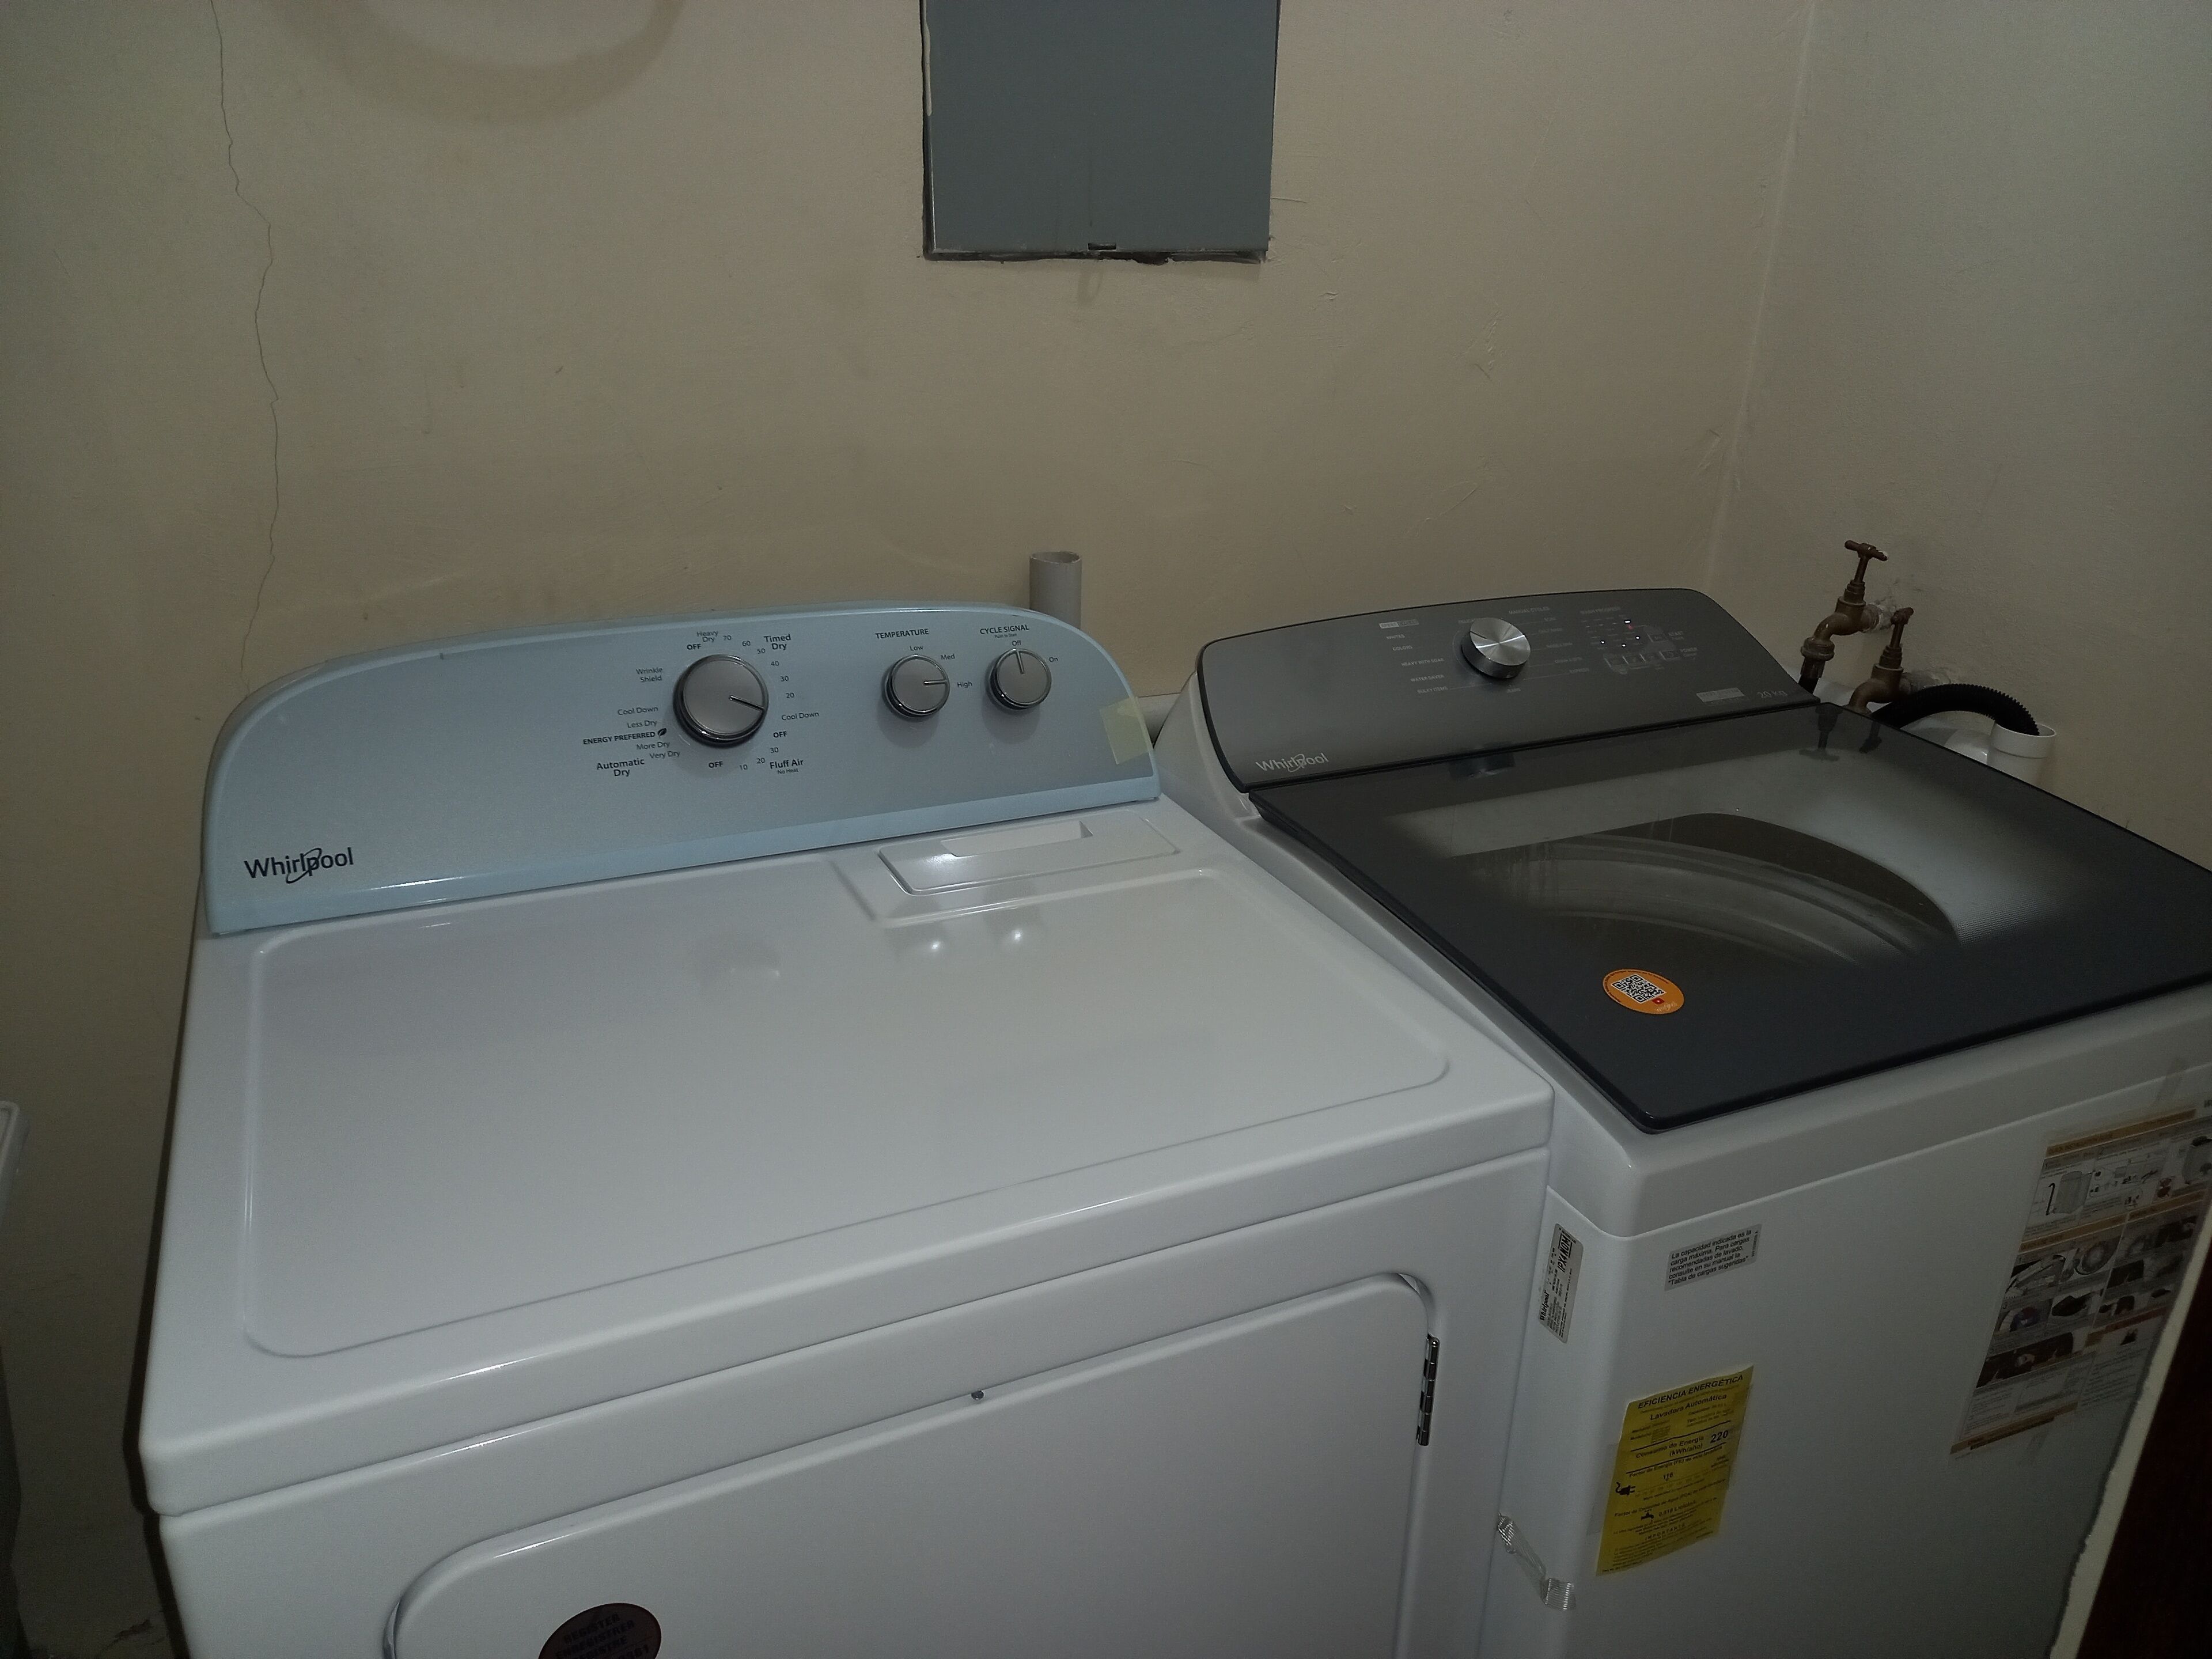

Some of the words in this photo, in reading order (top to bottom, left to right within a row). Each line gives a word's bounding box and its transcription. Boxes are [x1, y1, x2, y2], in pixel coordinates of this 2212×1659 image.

[764, 633, 791, 643] Timed
[875, 629, 929, 639] TEMPERATURE
[583, 736, 612, 744] ENERGY
[615, 732, 656, 741] PREFERRED
[597, 758, 645, 770] Automatic
[770, 760, 790, 769] Fluff
[791, 759, 804, 767] Air
[1255, 752, 1329, 772] Whirlpool
[613, 769, 630, 777] Dry
[244, 847, 354, 884] Whirlpool
[1671, 1257, 1687, 1266] carga
[1730, 1237, 1749, 1247] cargas
[1681, 1242, 1711, 1256] capacidad
[1712, 1235, 1736, 1245] indicada
[1670, 1255, 1713, 1272] recomendadas
[1712, 1254, 1734, 1266] manual
[1638, 1390, 1686, 1409] EFICIENCIA
[1687, 1374, 1743, 1395] ENERGÉTICA
[1650, 1406, 1684, 1421] Lavadora
[1685, 1394, 1727, 1409] Automática
[1710, 1430, 1729, 1444] 220
